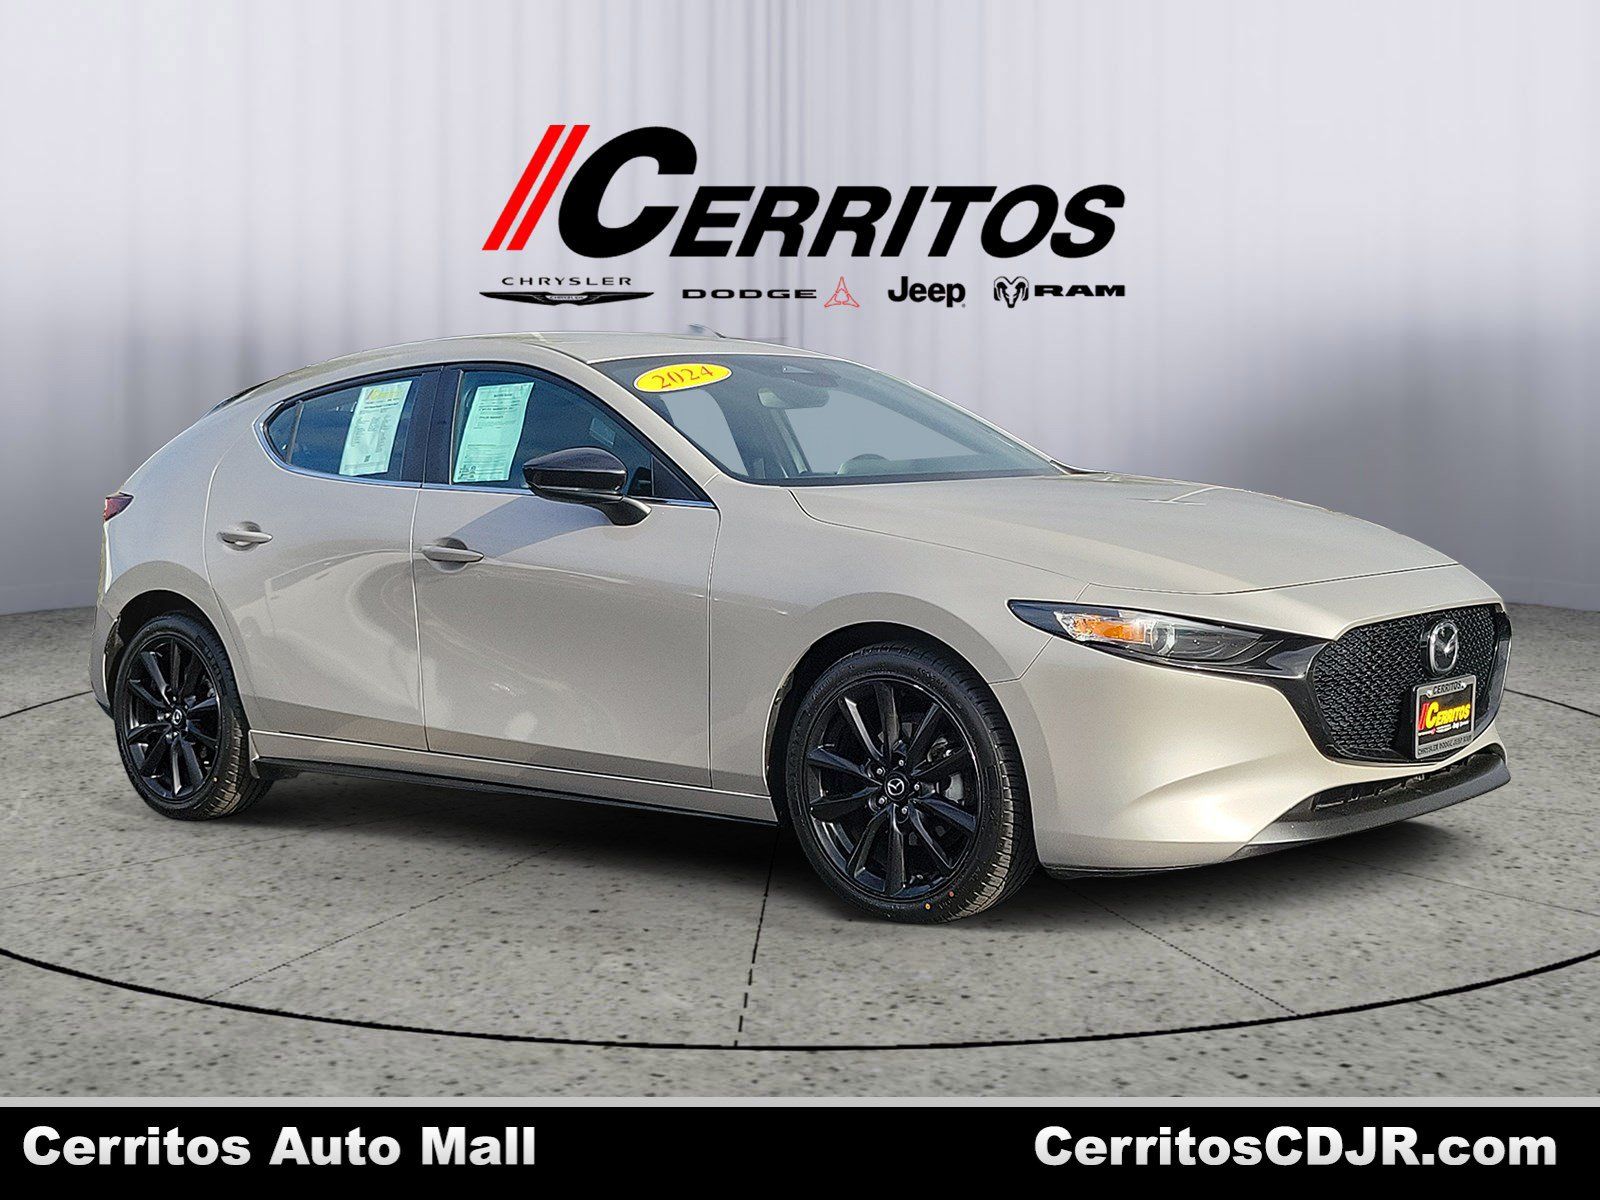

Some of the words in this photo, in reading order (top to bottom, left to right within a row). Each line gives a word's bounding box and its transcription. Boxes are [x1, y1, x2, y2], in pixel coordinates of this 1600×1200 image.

[651, 365, 714, 389] 2024
[1433, 681, 1462, 694] CERRITOS
[1426, 701, 1471, 729] CERRITOS
